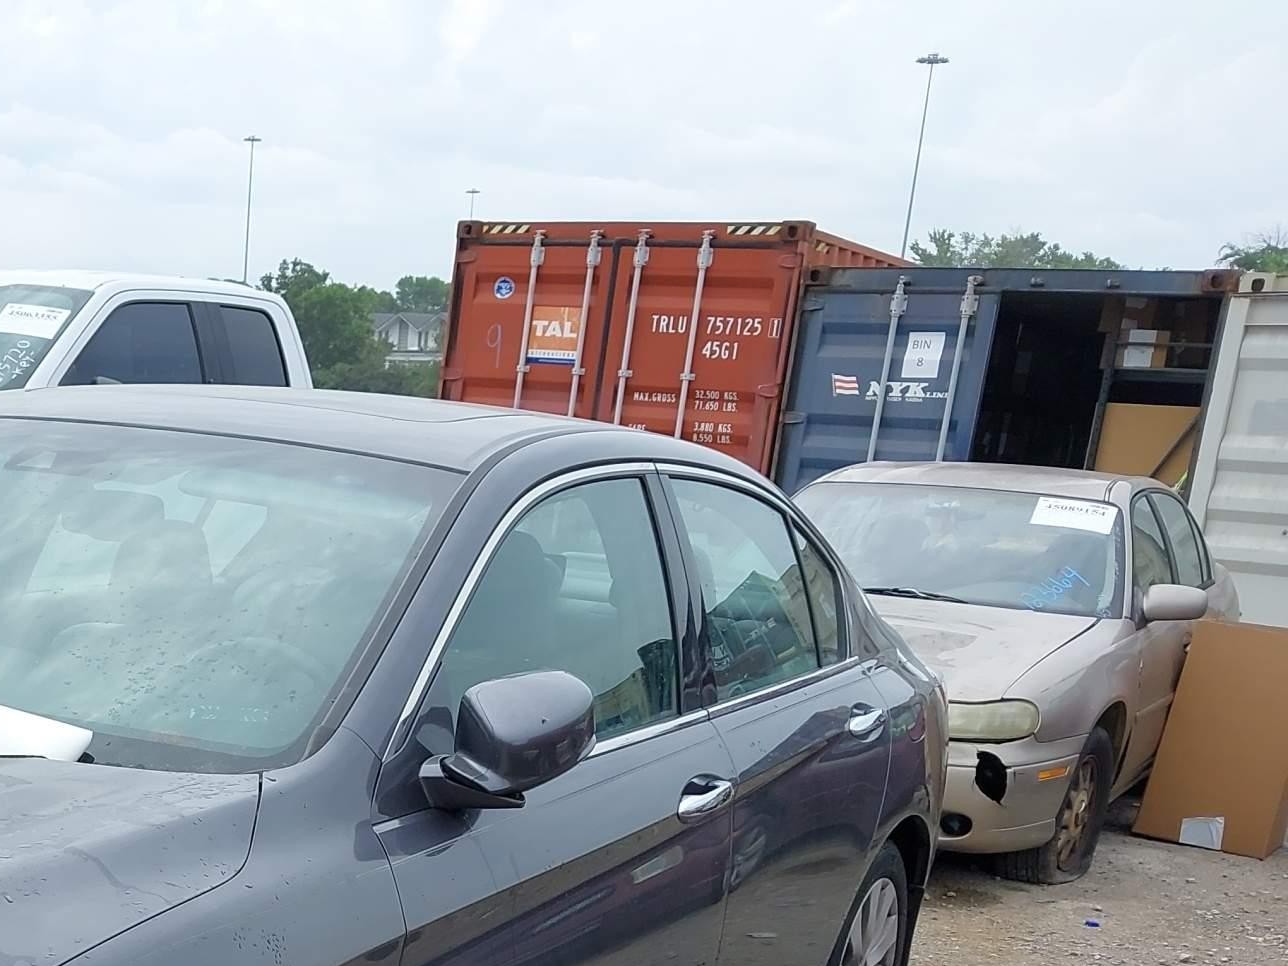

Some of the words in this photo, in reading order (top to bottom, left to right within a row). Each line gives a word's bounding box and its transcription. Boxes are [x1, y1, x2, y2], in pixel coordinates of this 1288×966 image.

[532, 320, 577, 338] TAL
[652, 314, 687, 334] TRLU
[706, 316, 762, 336] 757125
[702, 341, 739, 360] 45G1
[912, 339, 932, 350] BIN
[916, 357, 925, 367] 8
[866, 381, 929, 397] NYK
